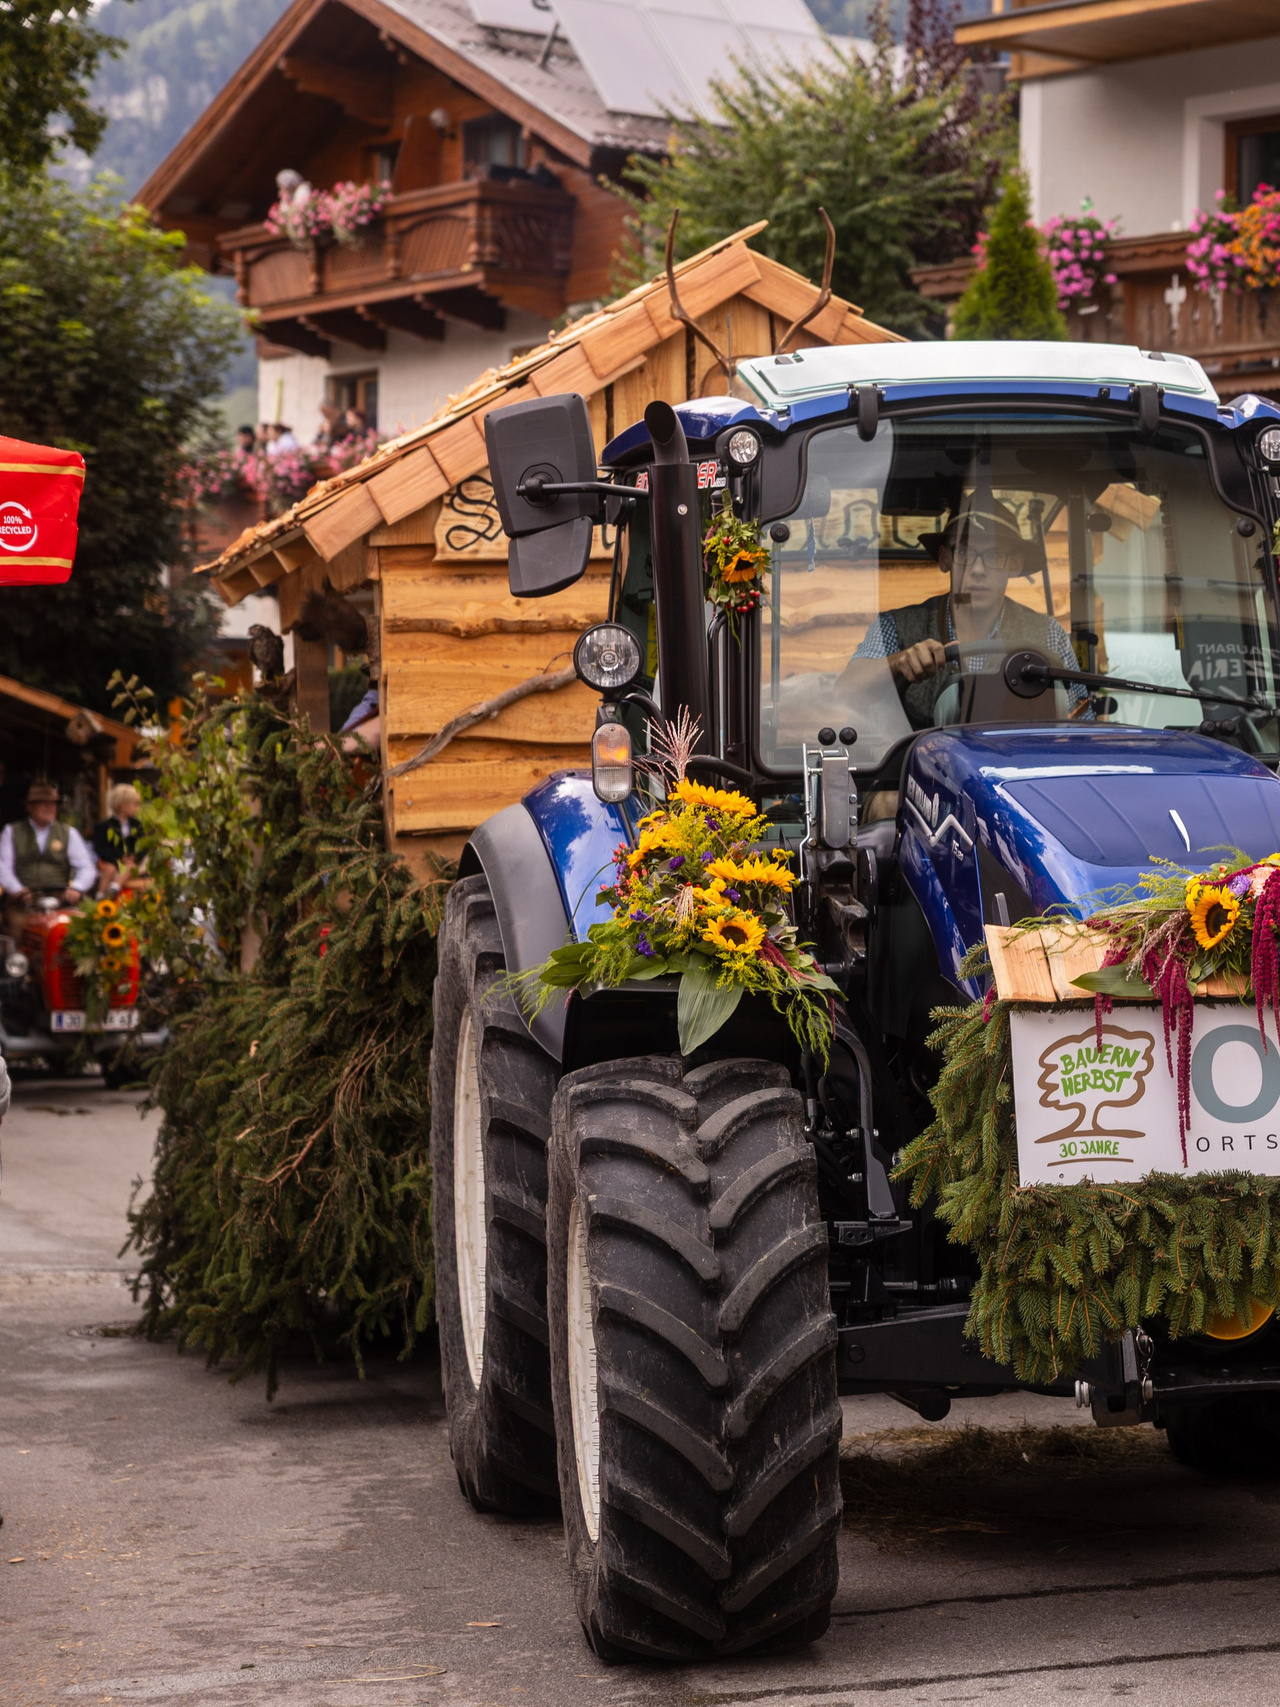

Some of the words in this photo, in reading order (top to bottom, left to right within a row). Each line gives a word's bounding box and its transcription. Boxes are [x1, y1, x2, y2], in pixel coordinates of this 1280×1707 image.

[3, 515, 23, 524] 100%
[0, 526, 32, 534] ECYCLED
[1060, 1043, 1141, 1076] BAUERN
[1060, 1069, 1133, 1098] HERBST
[1059, 1141, 1078, 1158] 30
[1079, 1139, 1120, 1156] JAHRE
